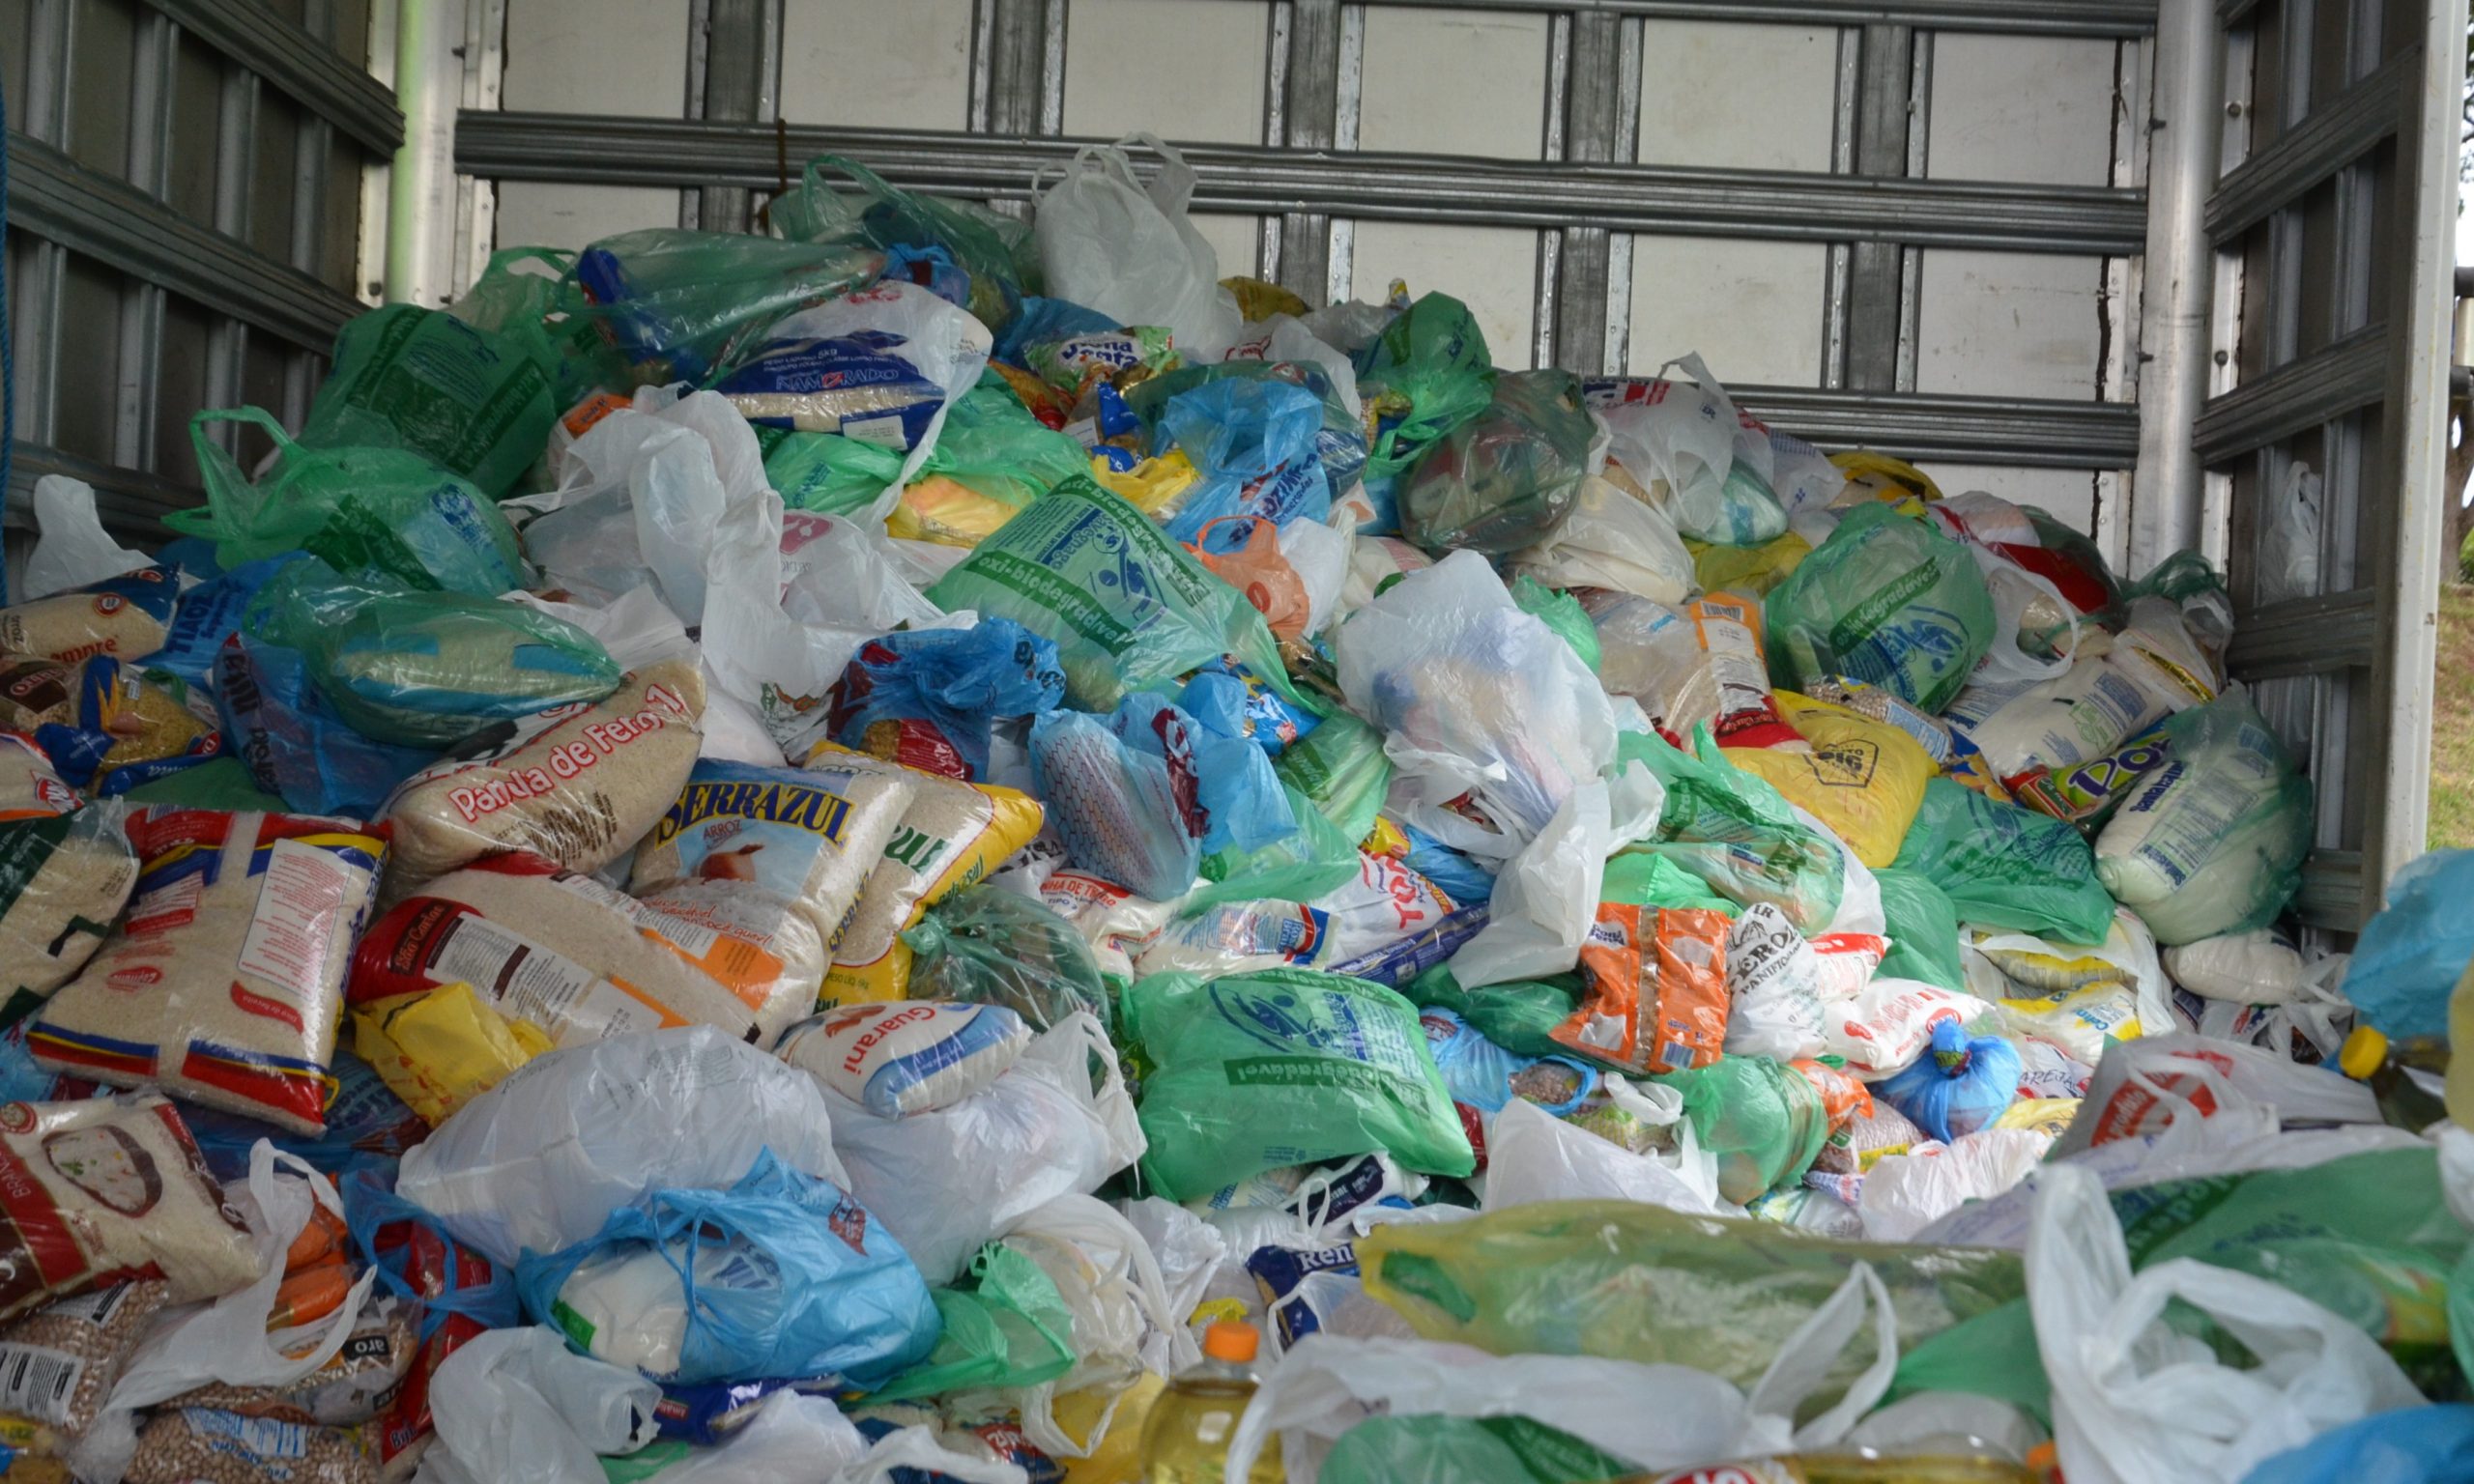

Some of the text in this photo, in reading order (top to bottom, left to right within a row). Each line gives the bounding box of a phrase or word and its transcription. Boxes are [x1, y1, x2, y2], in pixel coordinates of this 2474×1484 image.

[549, 738, 594, 779] de
[657, 780, 854, 851] SERRAZUL
[703, 818, 743, 841] ARROZ
[1064, 879, 1082, 894] DE
[843, 1006, 936, 1076] Guarani
[2021, 1069, 2078, 1090] AREJA
[1300, 1241, 1354, 1270] Ren
